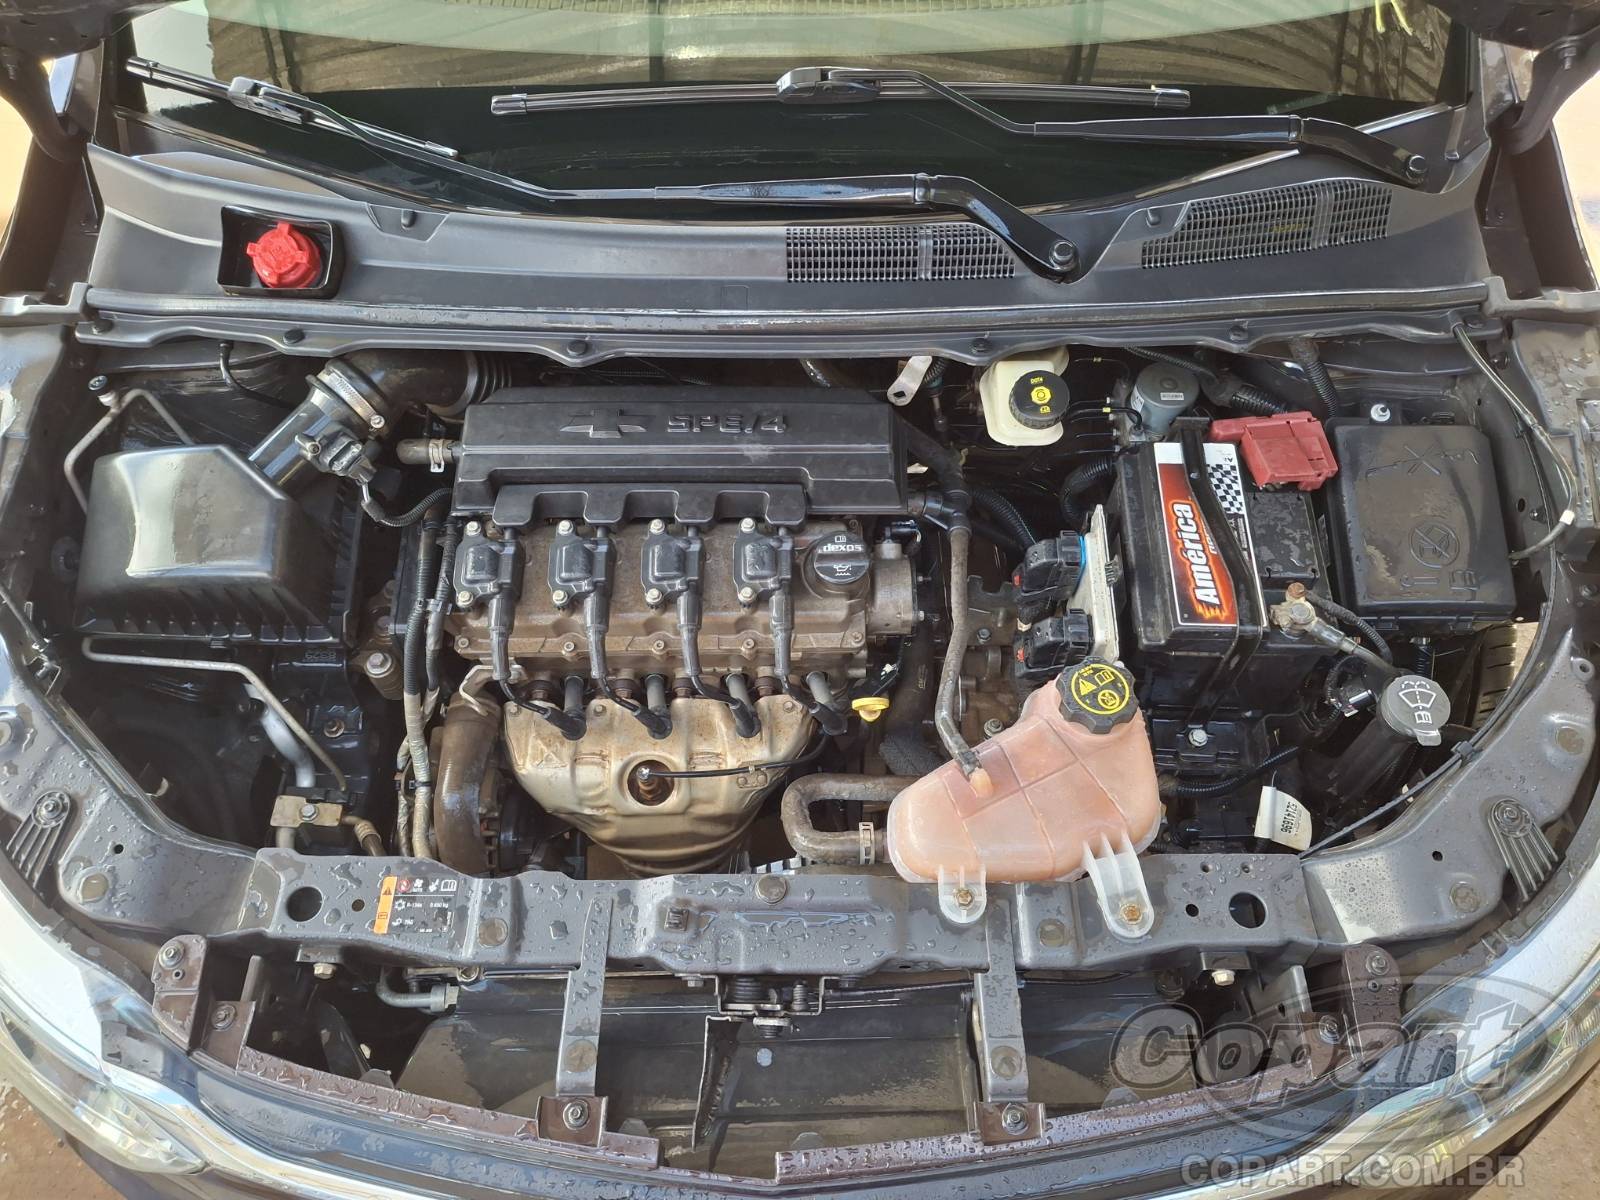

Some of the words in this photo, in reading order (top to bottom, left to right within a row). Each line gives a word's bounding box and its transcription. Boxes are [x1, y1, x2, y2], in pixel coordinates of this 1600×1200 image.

[667, 414, 786, 434] SPE/4
[823, 543, 862, 552] dexos
[1172, 503, 1221, 605] América
